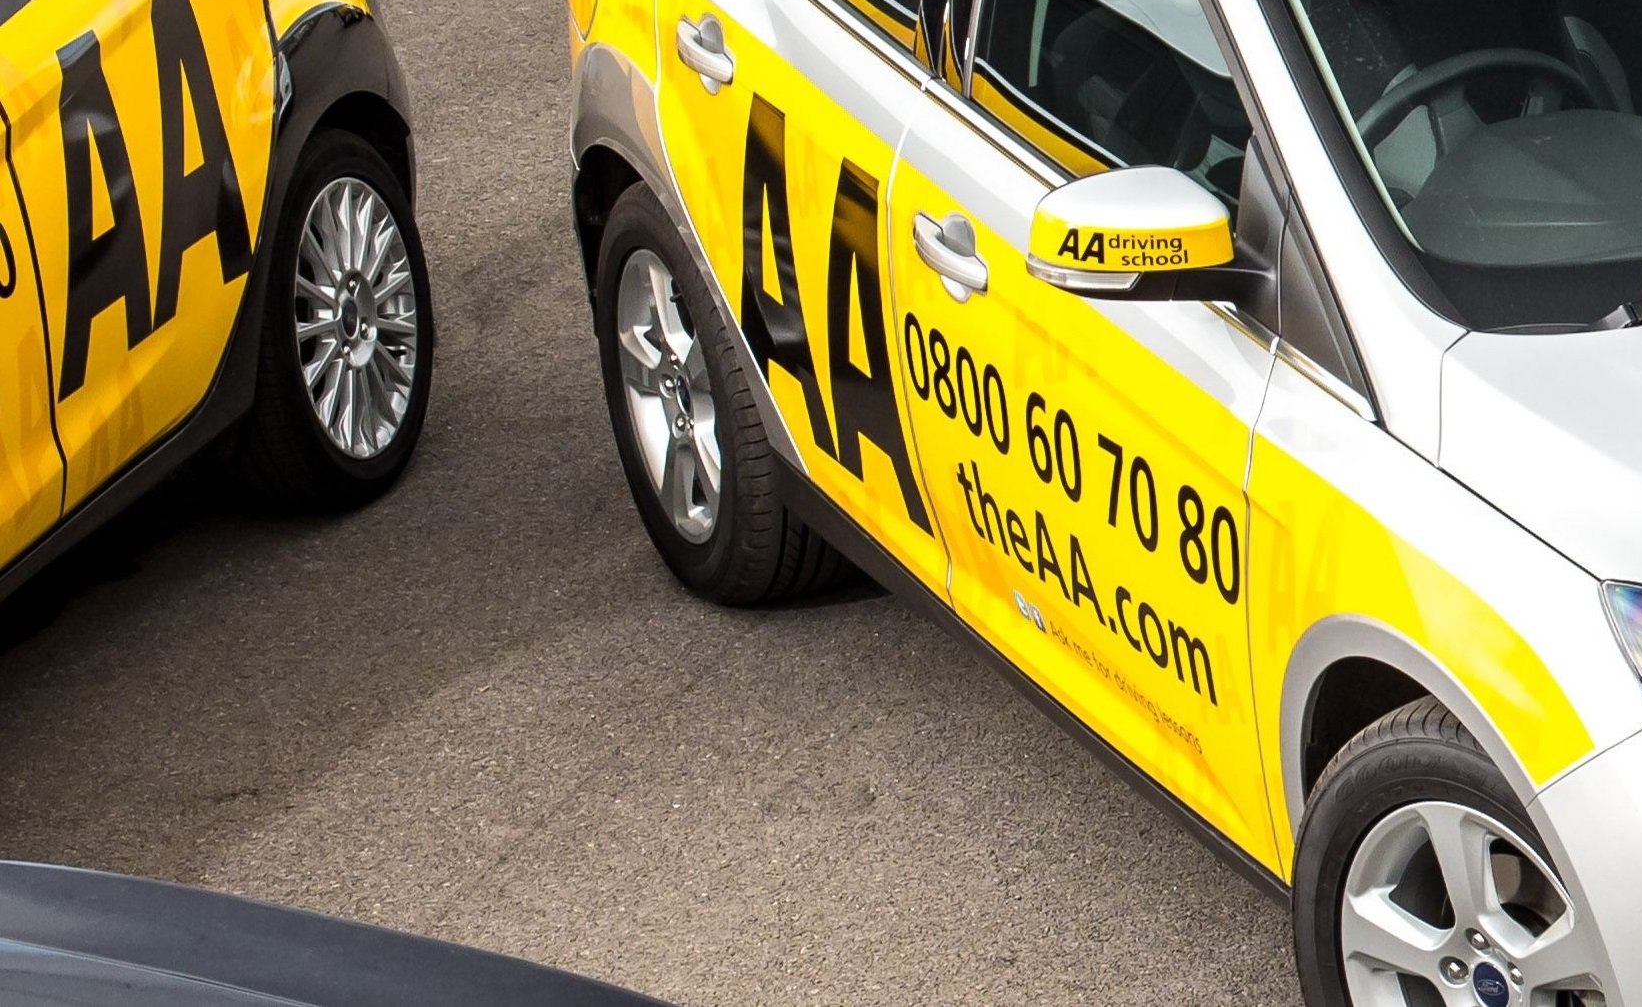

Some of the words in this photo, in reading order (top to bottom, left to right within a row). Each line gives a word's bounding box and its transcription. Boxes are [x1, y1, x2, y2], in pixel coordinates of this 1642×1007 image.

[740, 89, 934, 540] AA
[1057, 227, 1105, 264] AA
[1108, 233, 1183, 253] driving
[1121, 249, 1189, 267] school
[904, 311, 1010, 456] 0800
[1025, 391, 1082, 503] 60
[1097, 432, 1159, 554] 70
[1177, 484, 1240, 605] 80
[956, 460, 1218, 707] theAA.com
